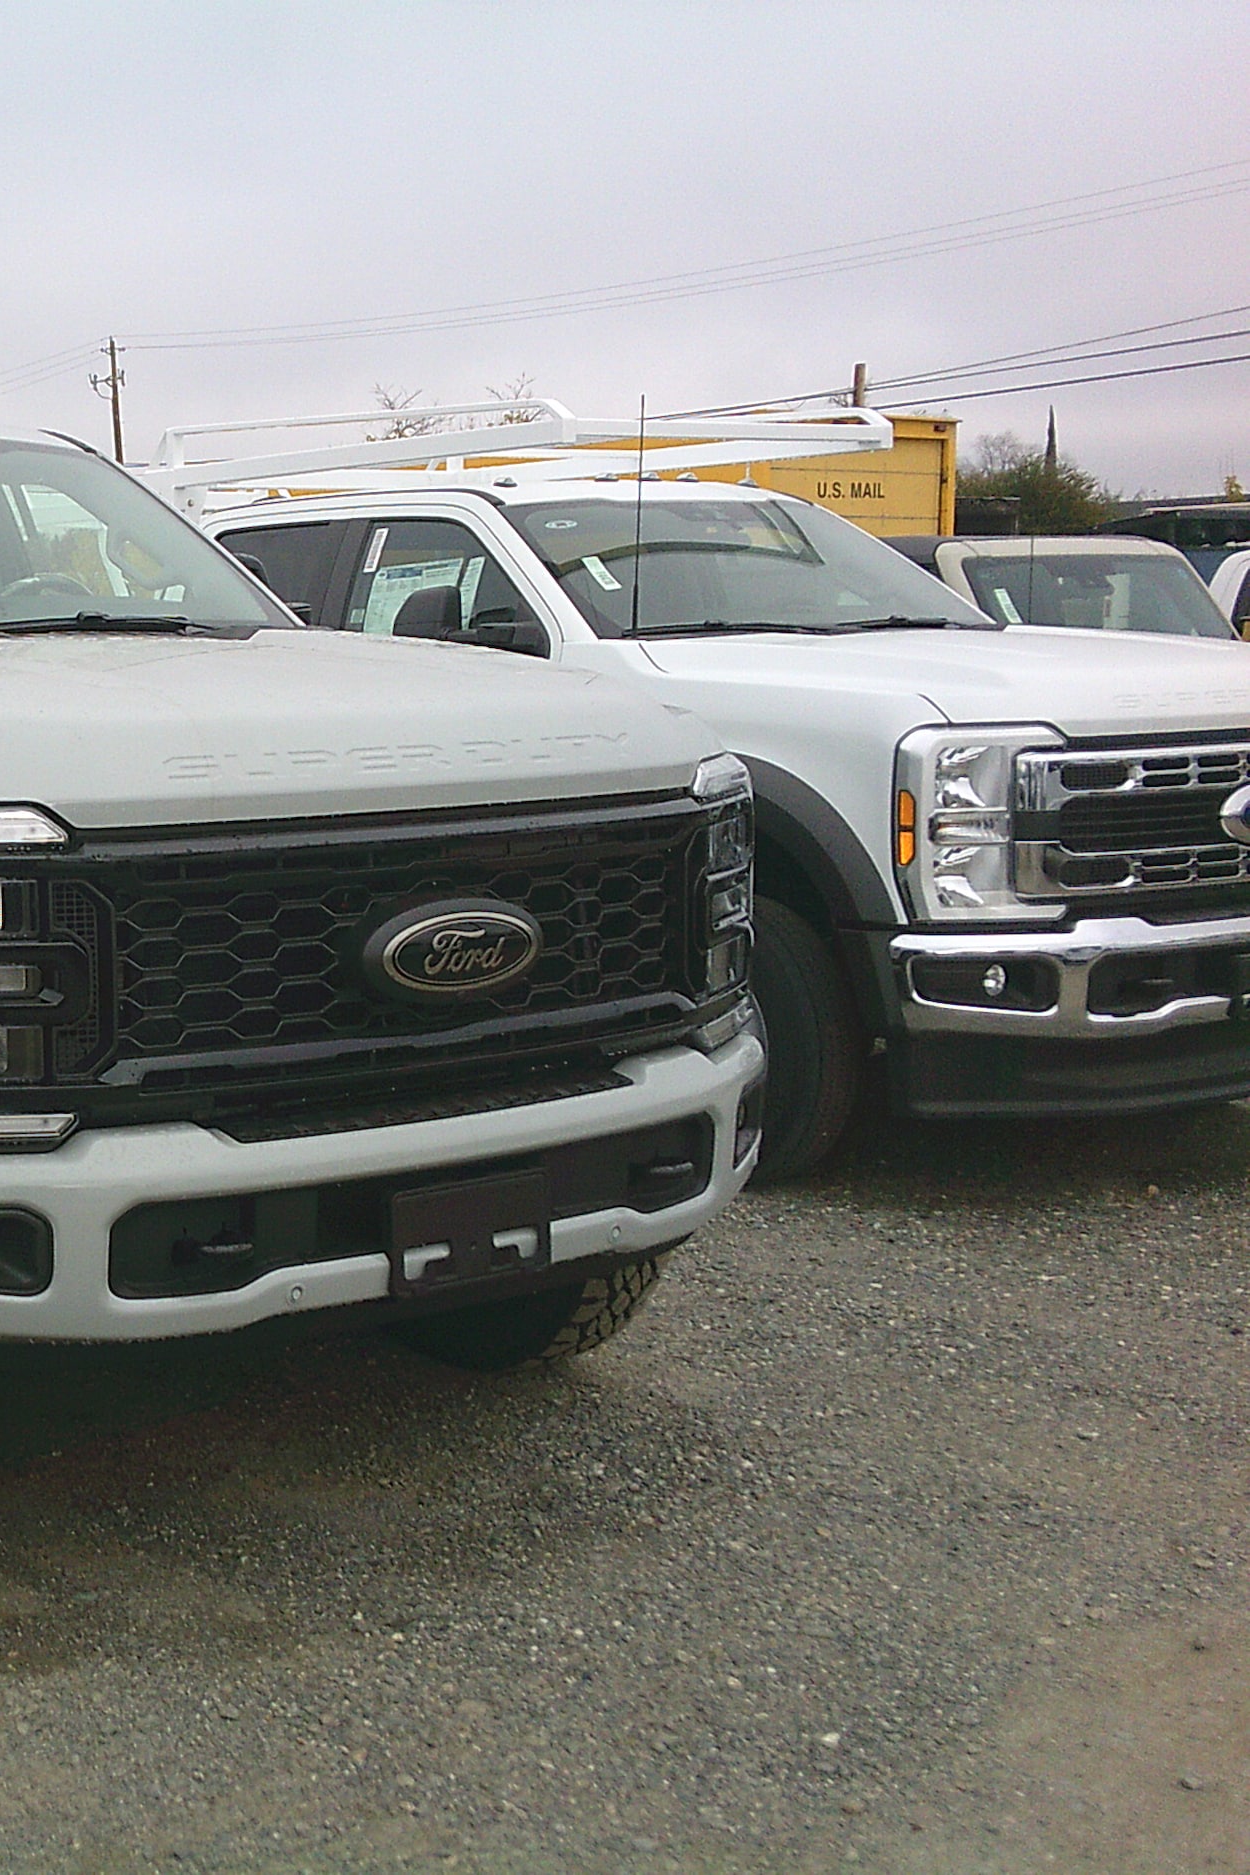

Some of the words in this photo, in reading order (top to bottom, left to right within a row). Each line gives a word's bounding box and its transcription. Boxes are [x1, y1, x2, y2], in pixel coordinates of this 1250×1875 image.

[816, 481, 846, 499] U.S.
[850, 481, 885, 499] MAIL
[423, 928, 506, 976] Ford
